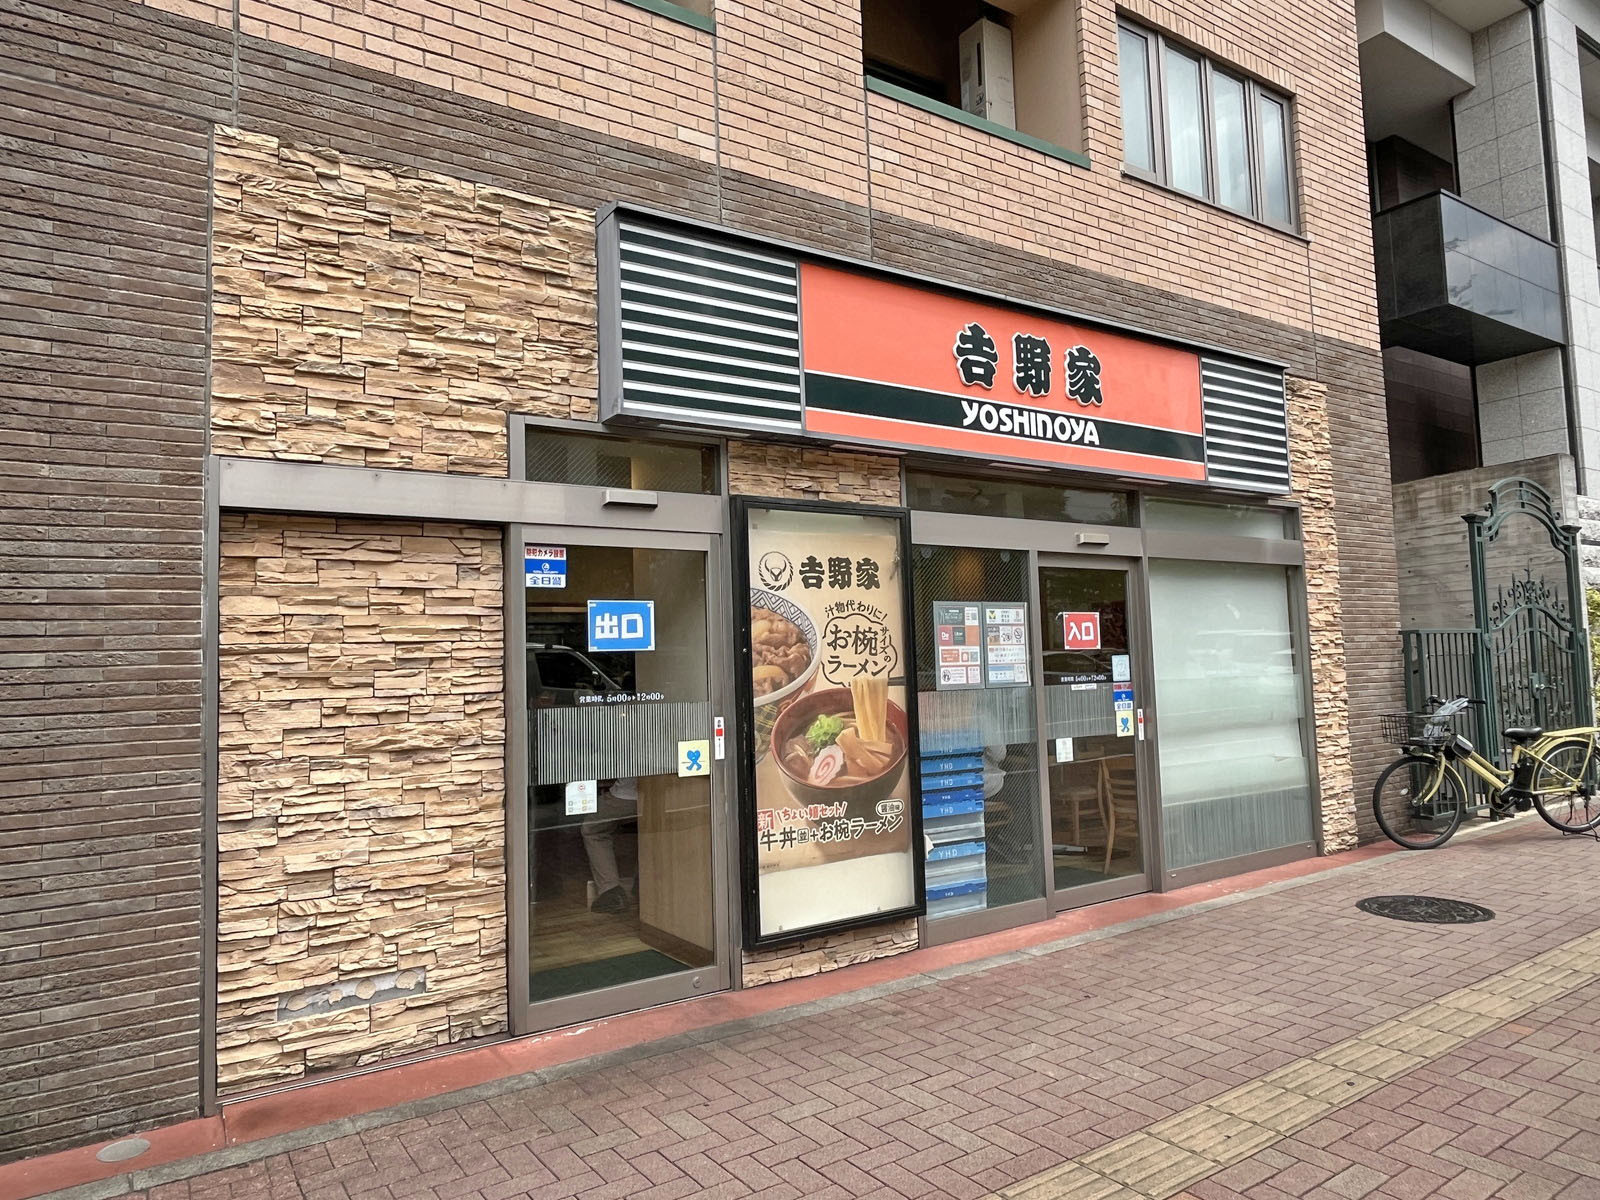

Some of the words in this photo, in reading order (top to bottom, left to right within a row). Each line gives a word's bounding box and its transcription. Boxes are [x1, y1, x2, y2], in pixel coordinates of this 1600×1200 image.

[953, 322, 1103, 407] 吉野家
[961, 400, 1100, 446] YOSHINOYA
[799, 555, 880, 590] 吉野家
[595, 613, 644, 640] 出口
[827, 623, 878, 656] お椀
[1068, 621, 1095, 641] 入口
[879, 626, 891, 663] サイズの
[827, 655, 888, 677] ラーメン
[939, 849, 958, 859] YHD
